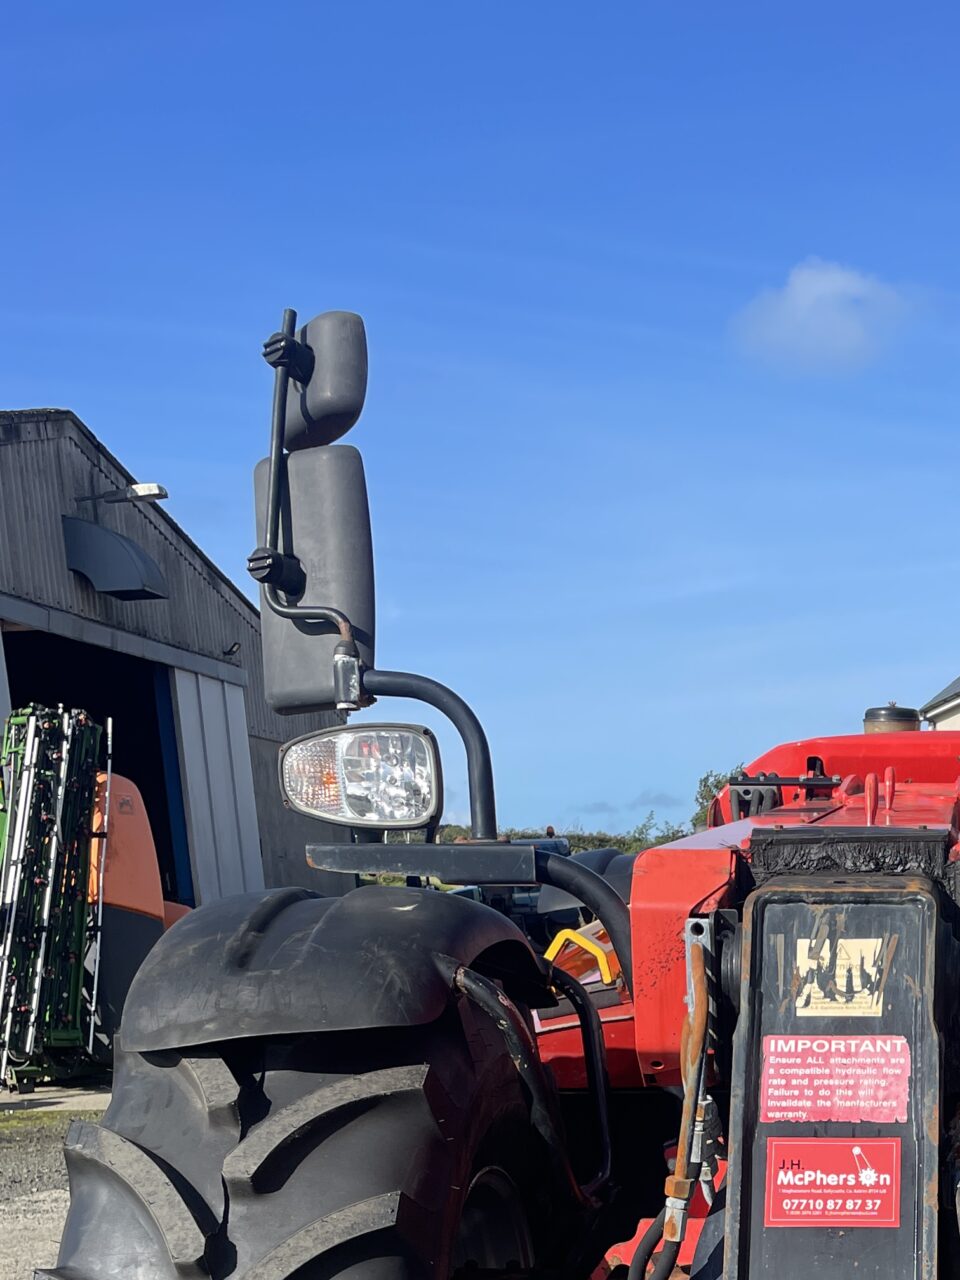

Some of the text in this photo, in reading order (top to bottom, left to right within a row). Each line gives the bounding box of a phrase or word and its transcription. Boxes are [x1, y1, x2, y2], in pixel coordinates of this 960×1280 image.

[769, 1039, 907, 1053] IMPORTANT
[769, 1056, 802, 1064] Ensure
[806, 1056, 825, 1064] ALL
[779, 1067, 831, 1077] compatible
[835, 1067, 878, 1077] hydraulic
[882, 1067, 902, 1075] flow
[768, 1078, 787, 1086] rate
[791, 1078, 809, 1086] and
[813, 1079, 855, 1087] pressure
[768, 1088, 800, 1096] Failure
[835, 1088, 853, 1096] this
[857, 1088, 874, 1096] will
[816, 1099, 832, 1107] the
[767, 1111, 808, 1120] warranty.
[779, 1159, 805, 1170] J.H.
[782, 1199, 881, 1210] 07710 87 87 37
